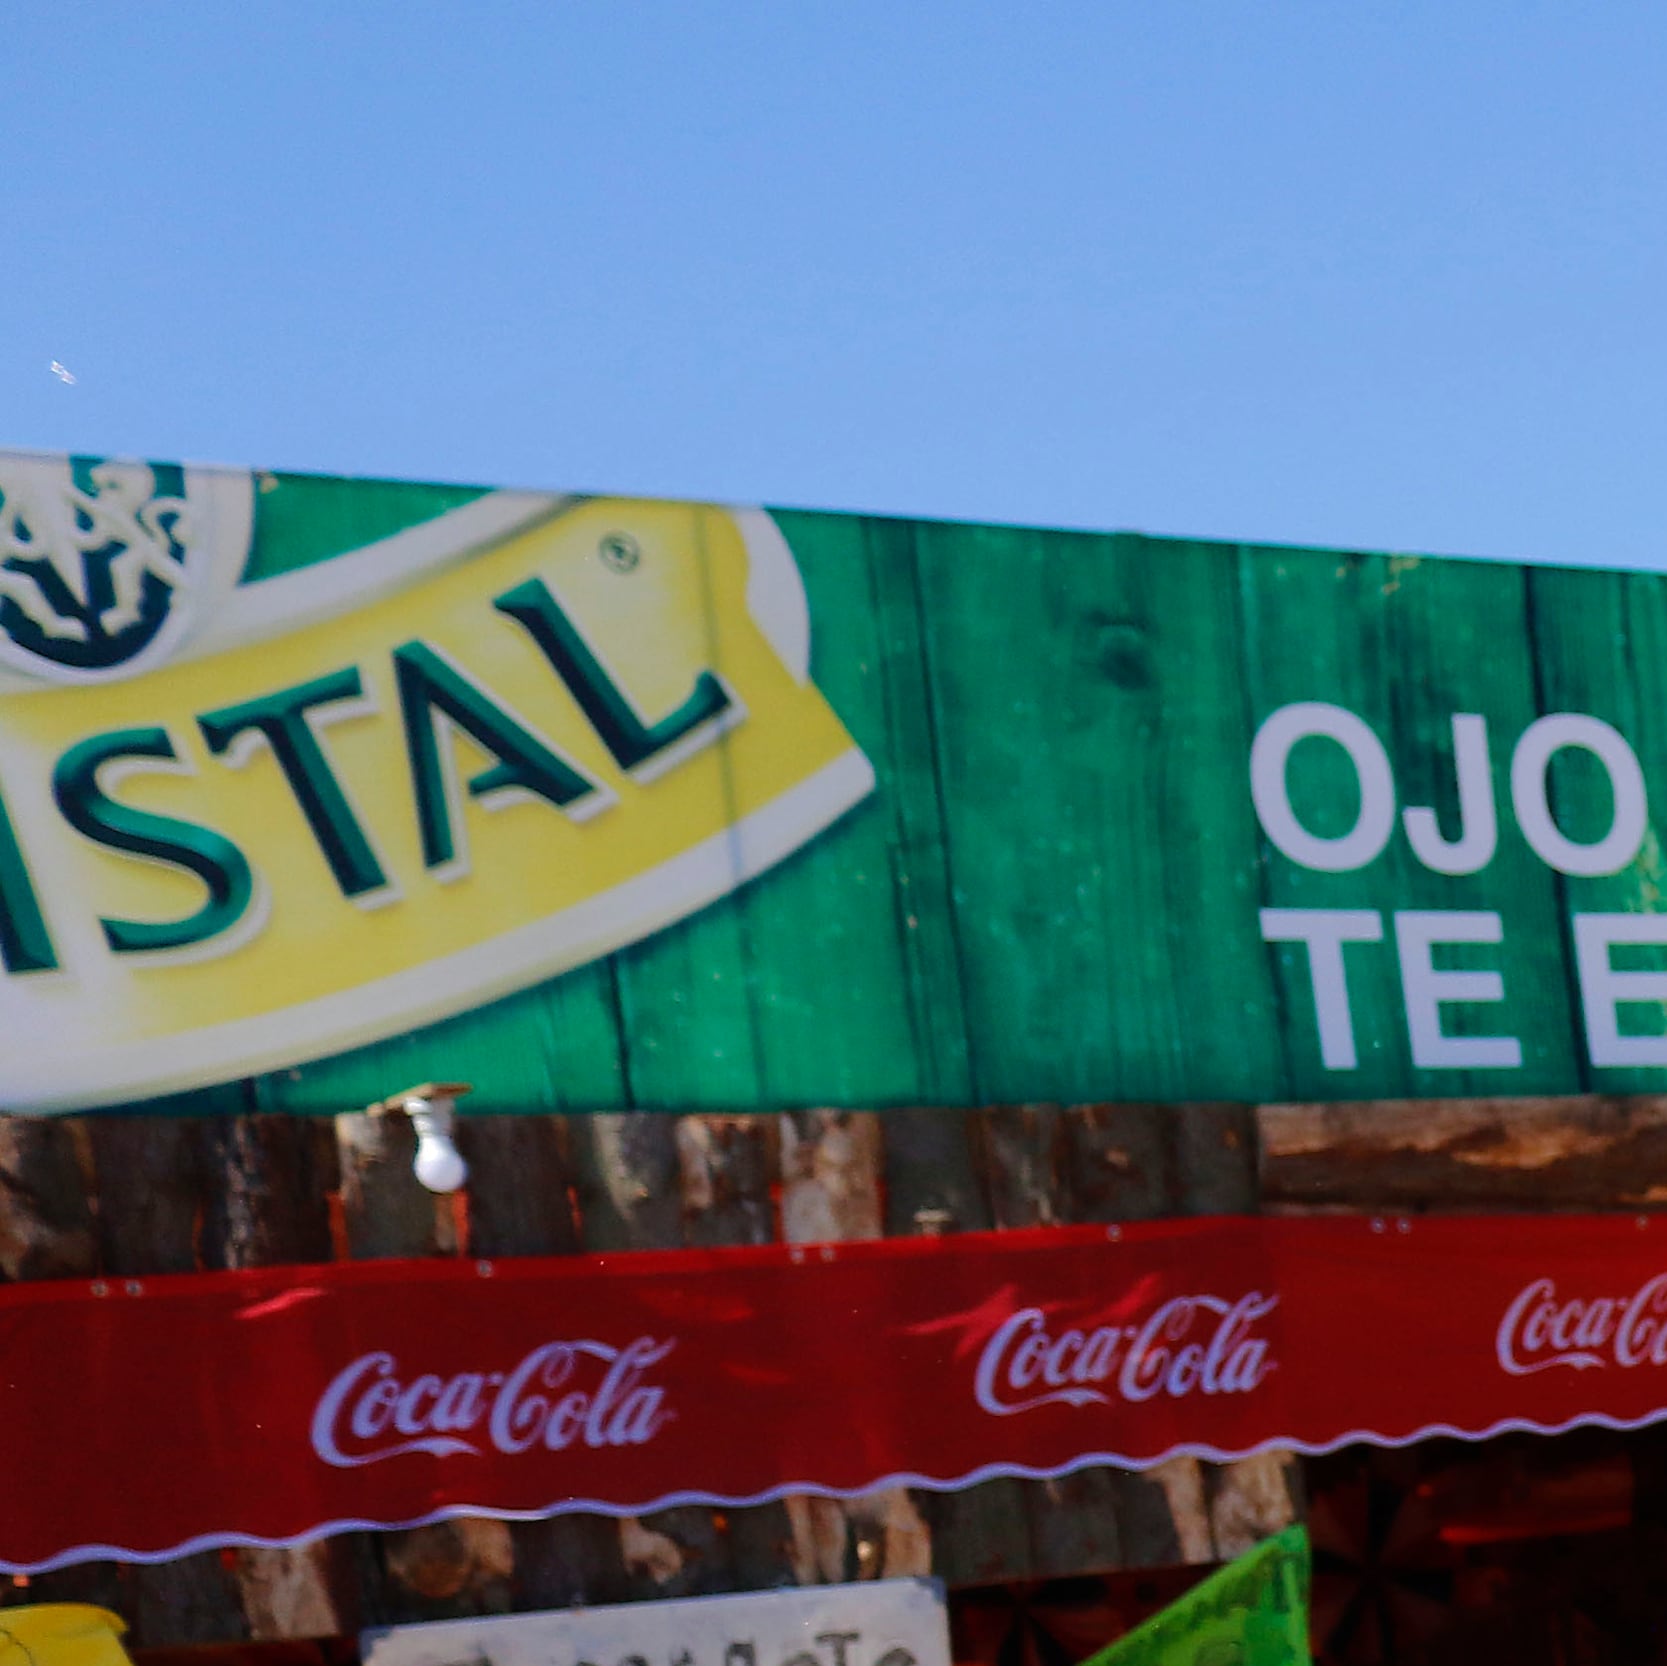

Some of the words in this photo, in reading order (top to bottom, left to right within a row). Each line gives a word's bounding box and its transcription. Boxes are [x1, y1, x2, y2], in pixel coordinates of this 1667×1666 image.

[1249, 701, 1648, 877] OJO
[1259, 907, 1523, 1072] TE
[312, 1334, 677, 1468] Coca-Cola
[975, 1290, 1278, 1416] Coca-Cola
